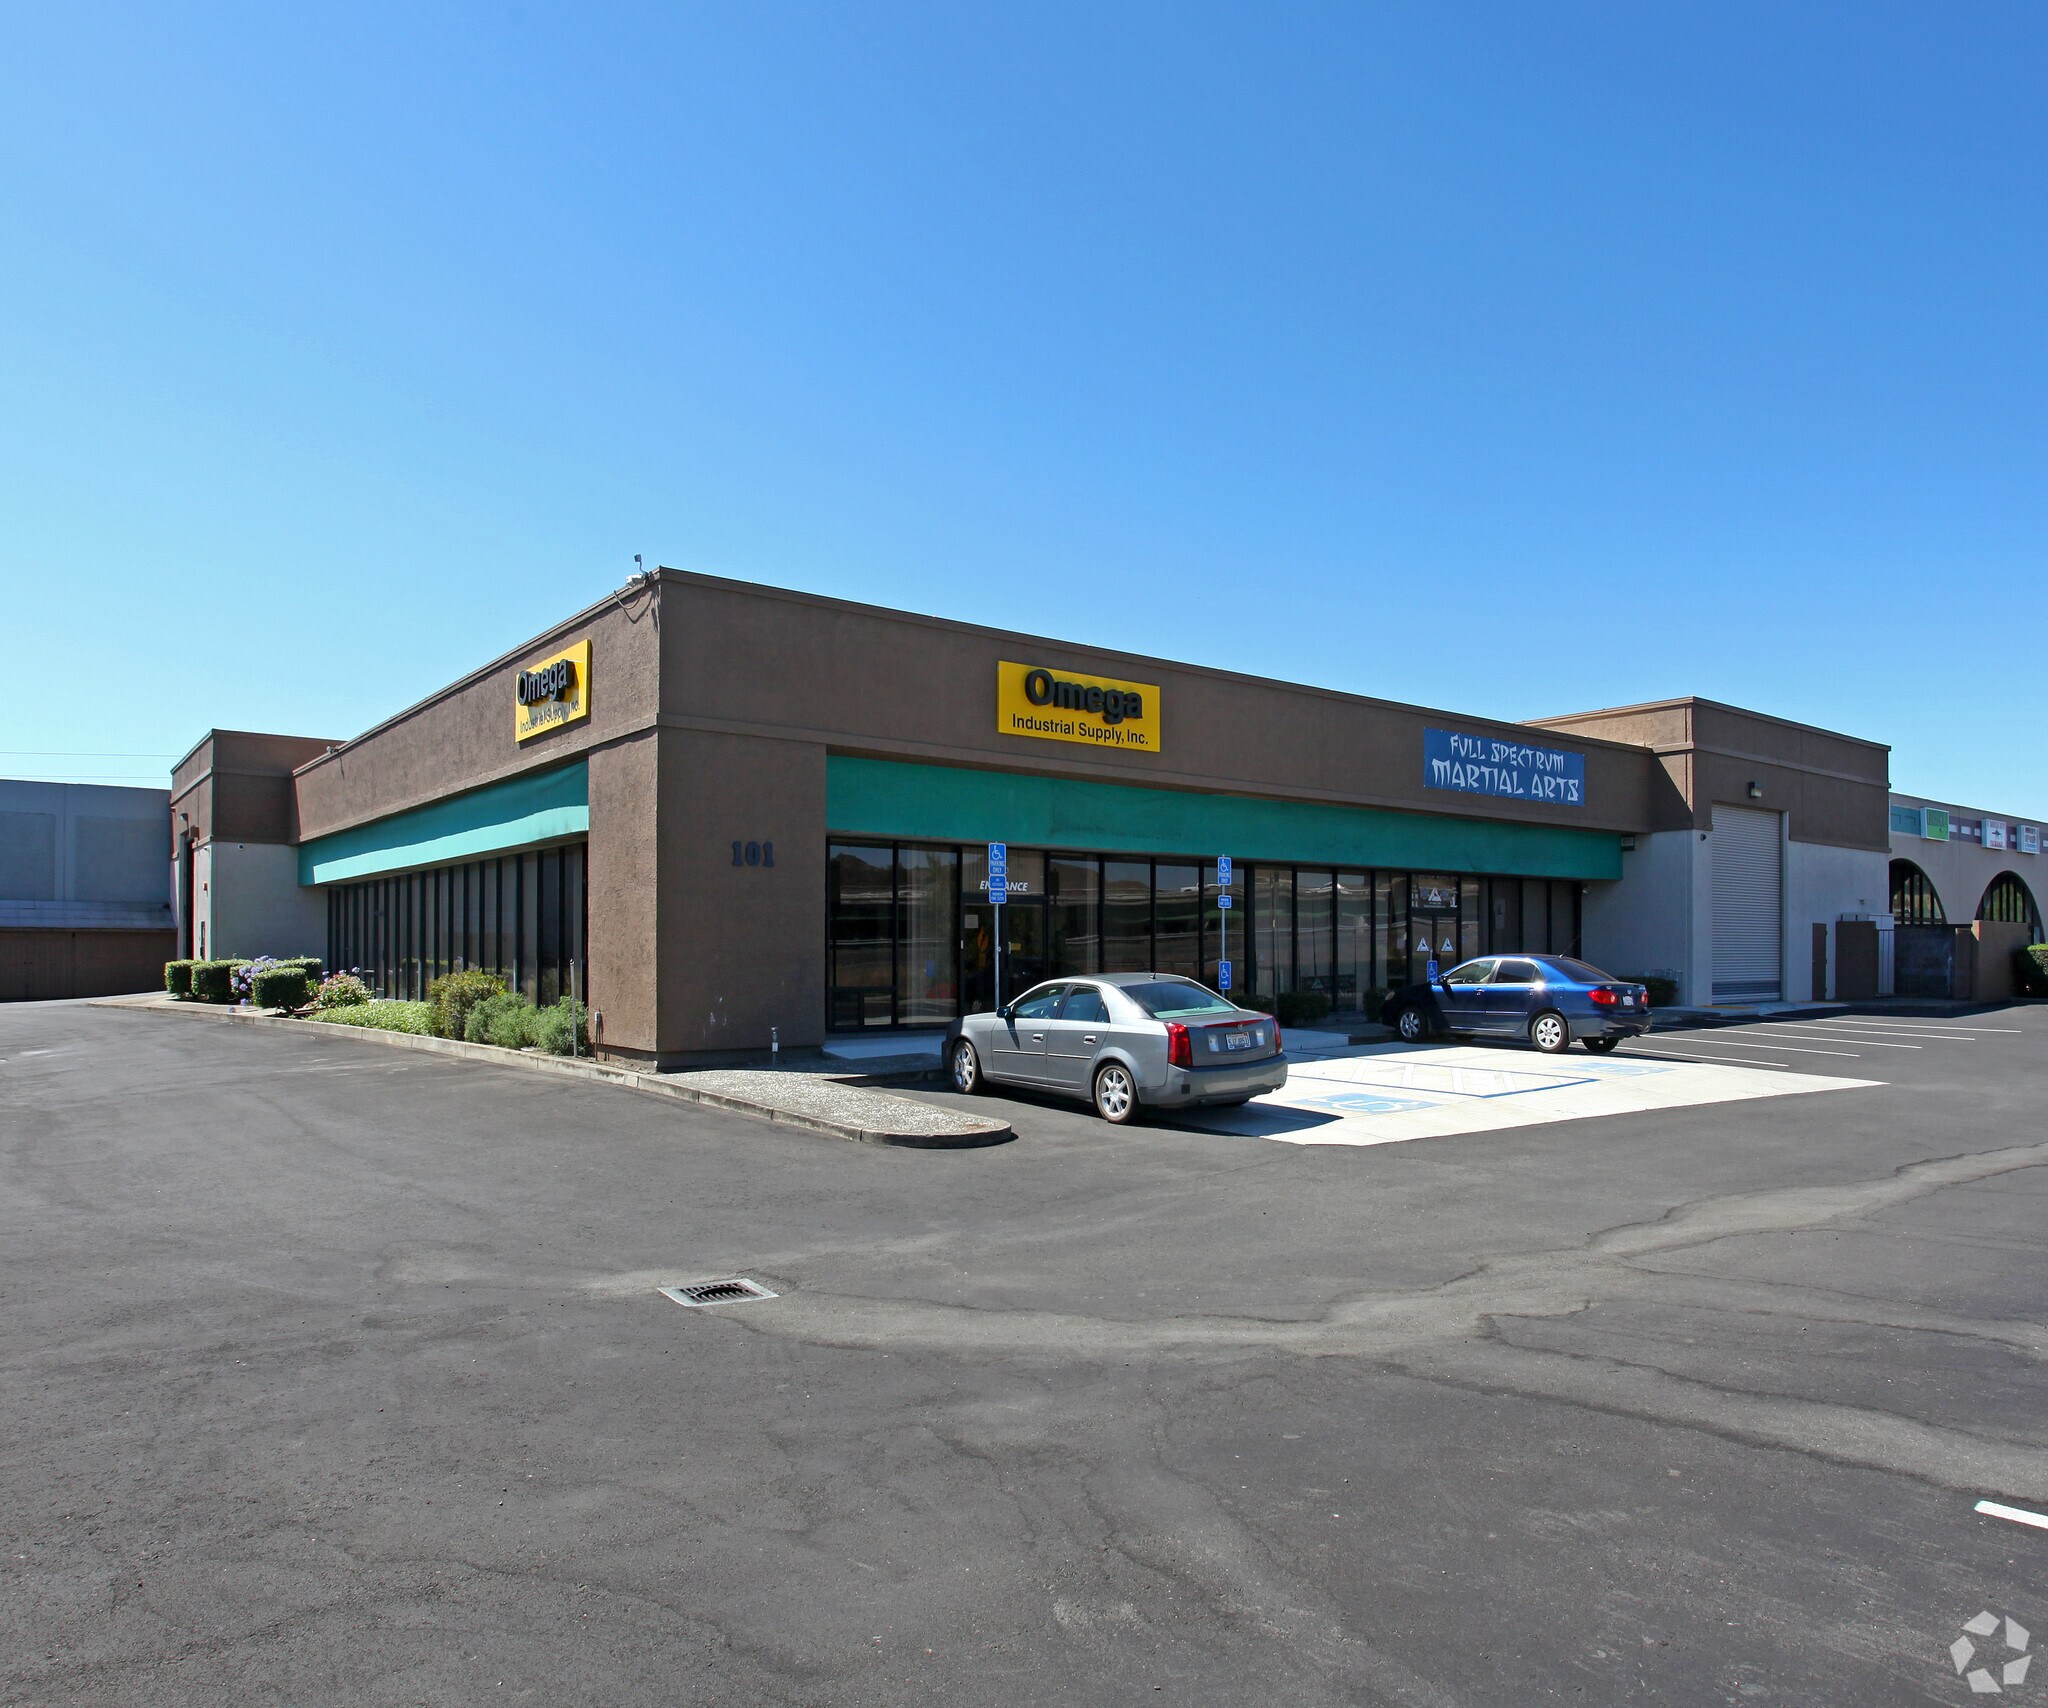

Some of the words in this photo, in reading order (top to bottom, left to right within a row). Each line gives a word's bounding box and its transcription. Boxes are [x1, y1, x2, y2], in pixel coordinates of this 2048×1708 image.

[517, 659, 568, 706] Omega
[1025, 669, 1143, 724] Omega
[1012, 713, 1075, 735] Industrial
[1078, 722, 1125, 744] Supply,
[1127, 729, 1149, 745] Inc.
[1450, 734, 1486, 759] FULL
[1491, 743, 1564, 773] SPECTRUM
[1431, 758, 1525, 794] MARTIAL
[1531, 773, 1579, 801] ARTS
[731, 841, 775, 867] 101
